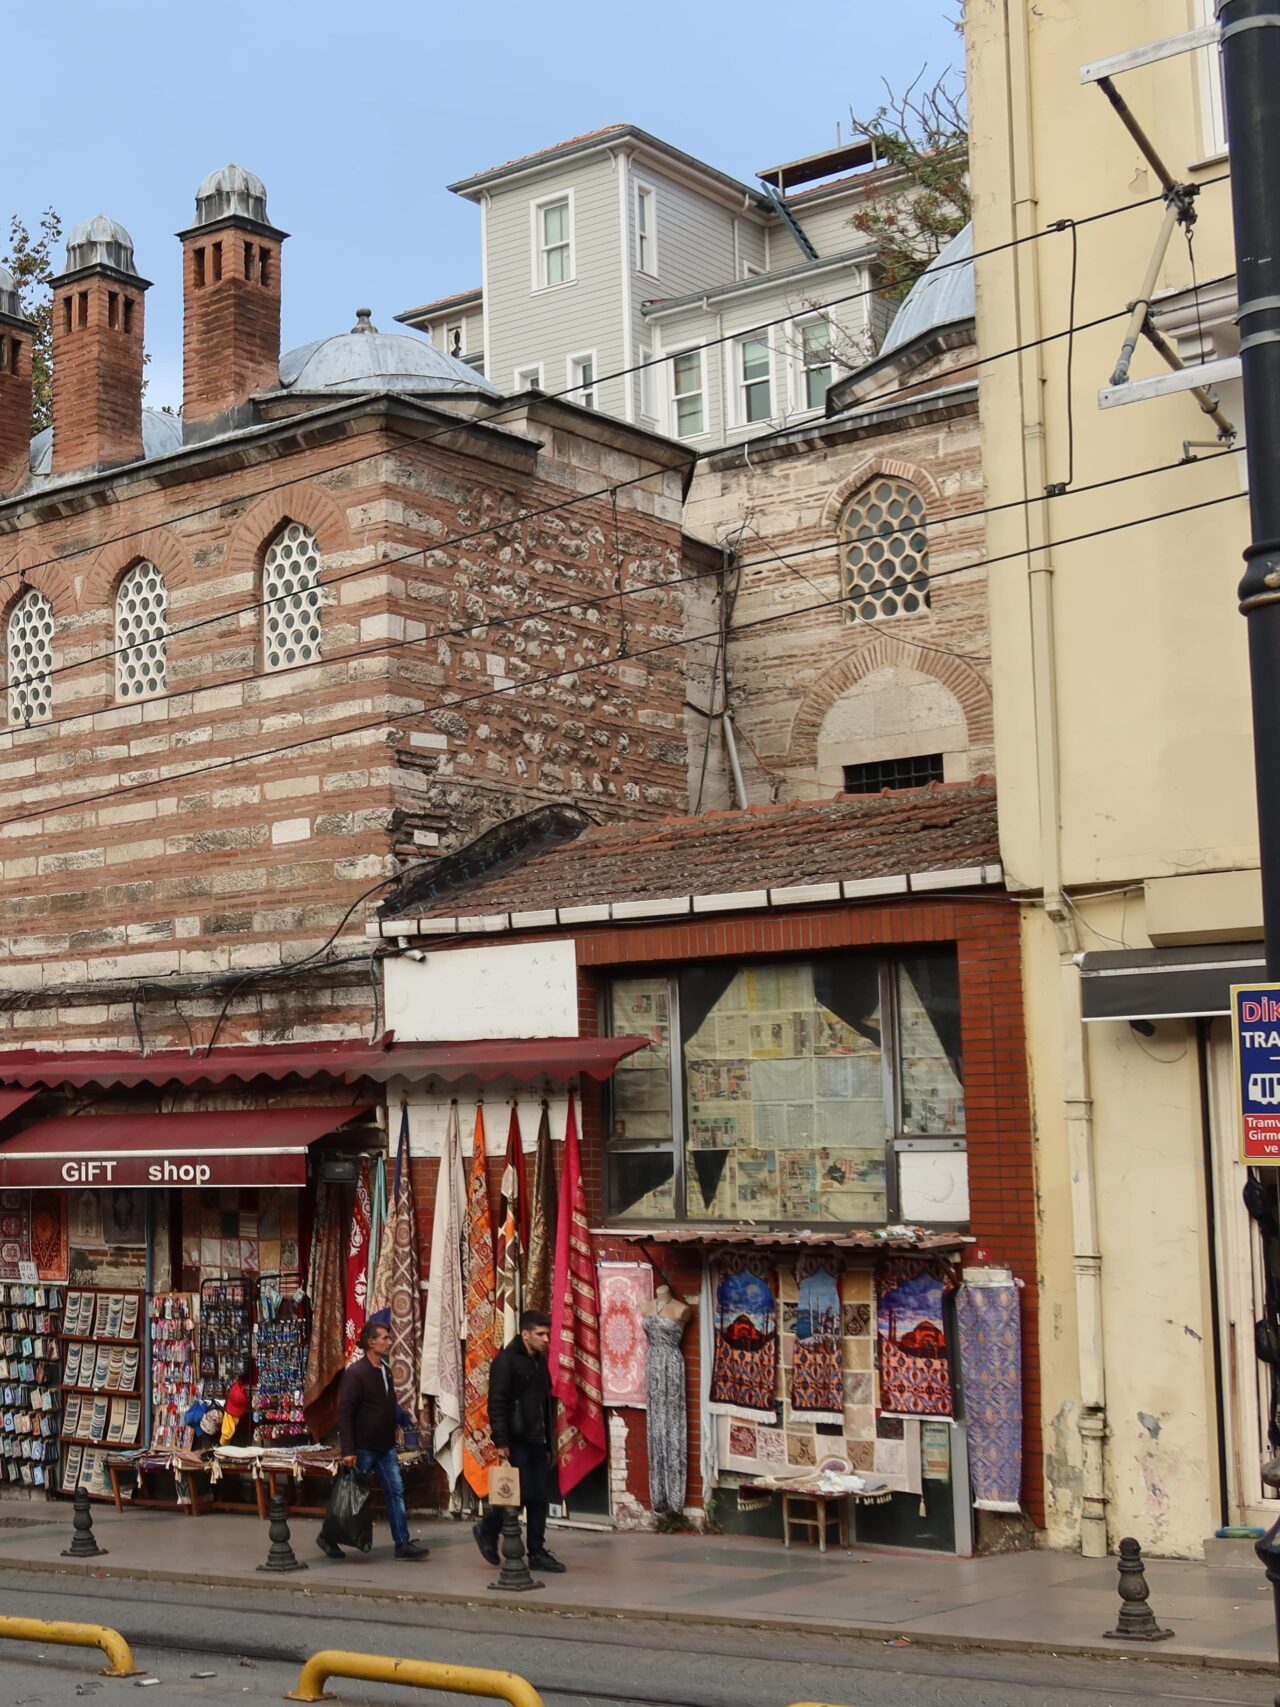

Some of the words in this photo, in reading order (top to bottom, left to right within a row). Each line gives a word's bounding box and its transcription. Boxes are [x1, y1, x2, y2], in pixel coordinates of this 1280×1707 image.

[1241, 1031, 1280, 1049] TRA
[1264, 1145, 1279, 1153] ve
[148, 1160, 211, 1185] shop
